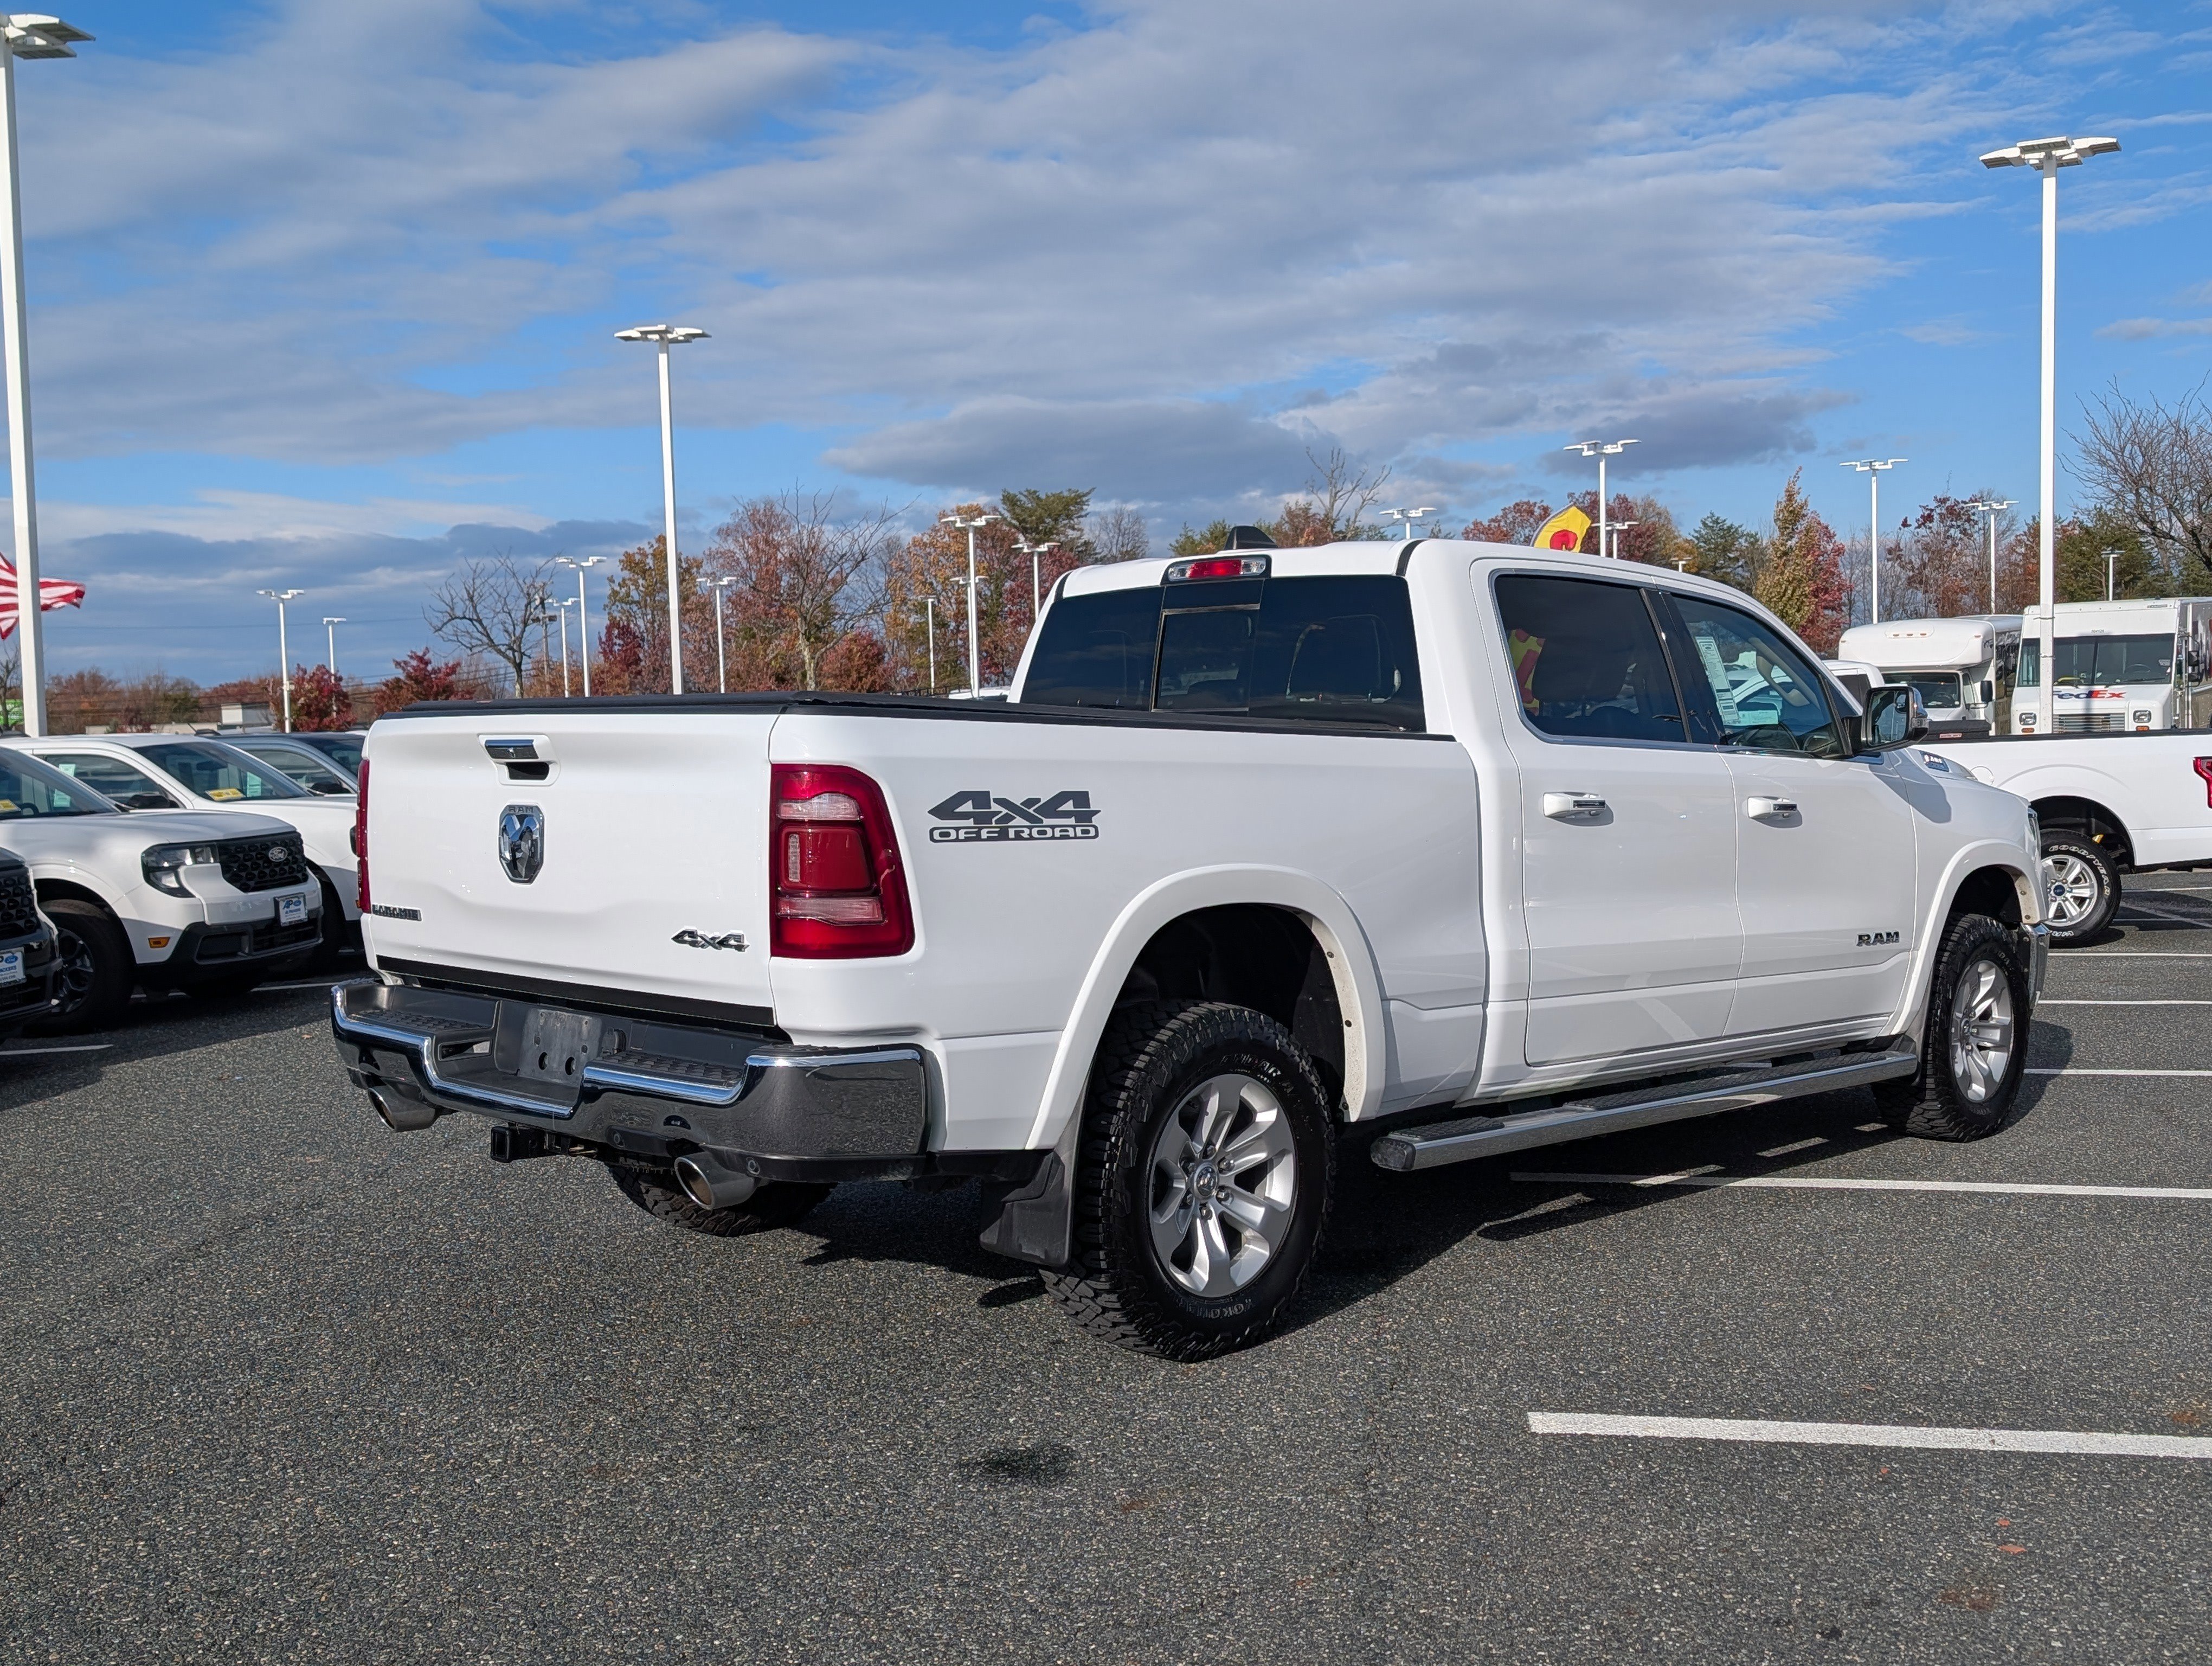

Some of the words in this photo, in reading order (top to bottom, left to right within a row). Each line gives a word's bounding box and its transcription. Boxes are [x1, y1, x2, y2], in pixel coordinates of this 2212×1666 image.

[928, 791, 1101, 824] 4x4
[933, 829, 1000, 840] OFF
[1008, 827, 1095, 838] ROAD
[2048, 844, 2110, 896] GOODYEAR
[671, 928, 750, 952] 4x4
[1856, 931, 1899, 946] RAM
